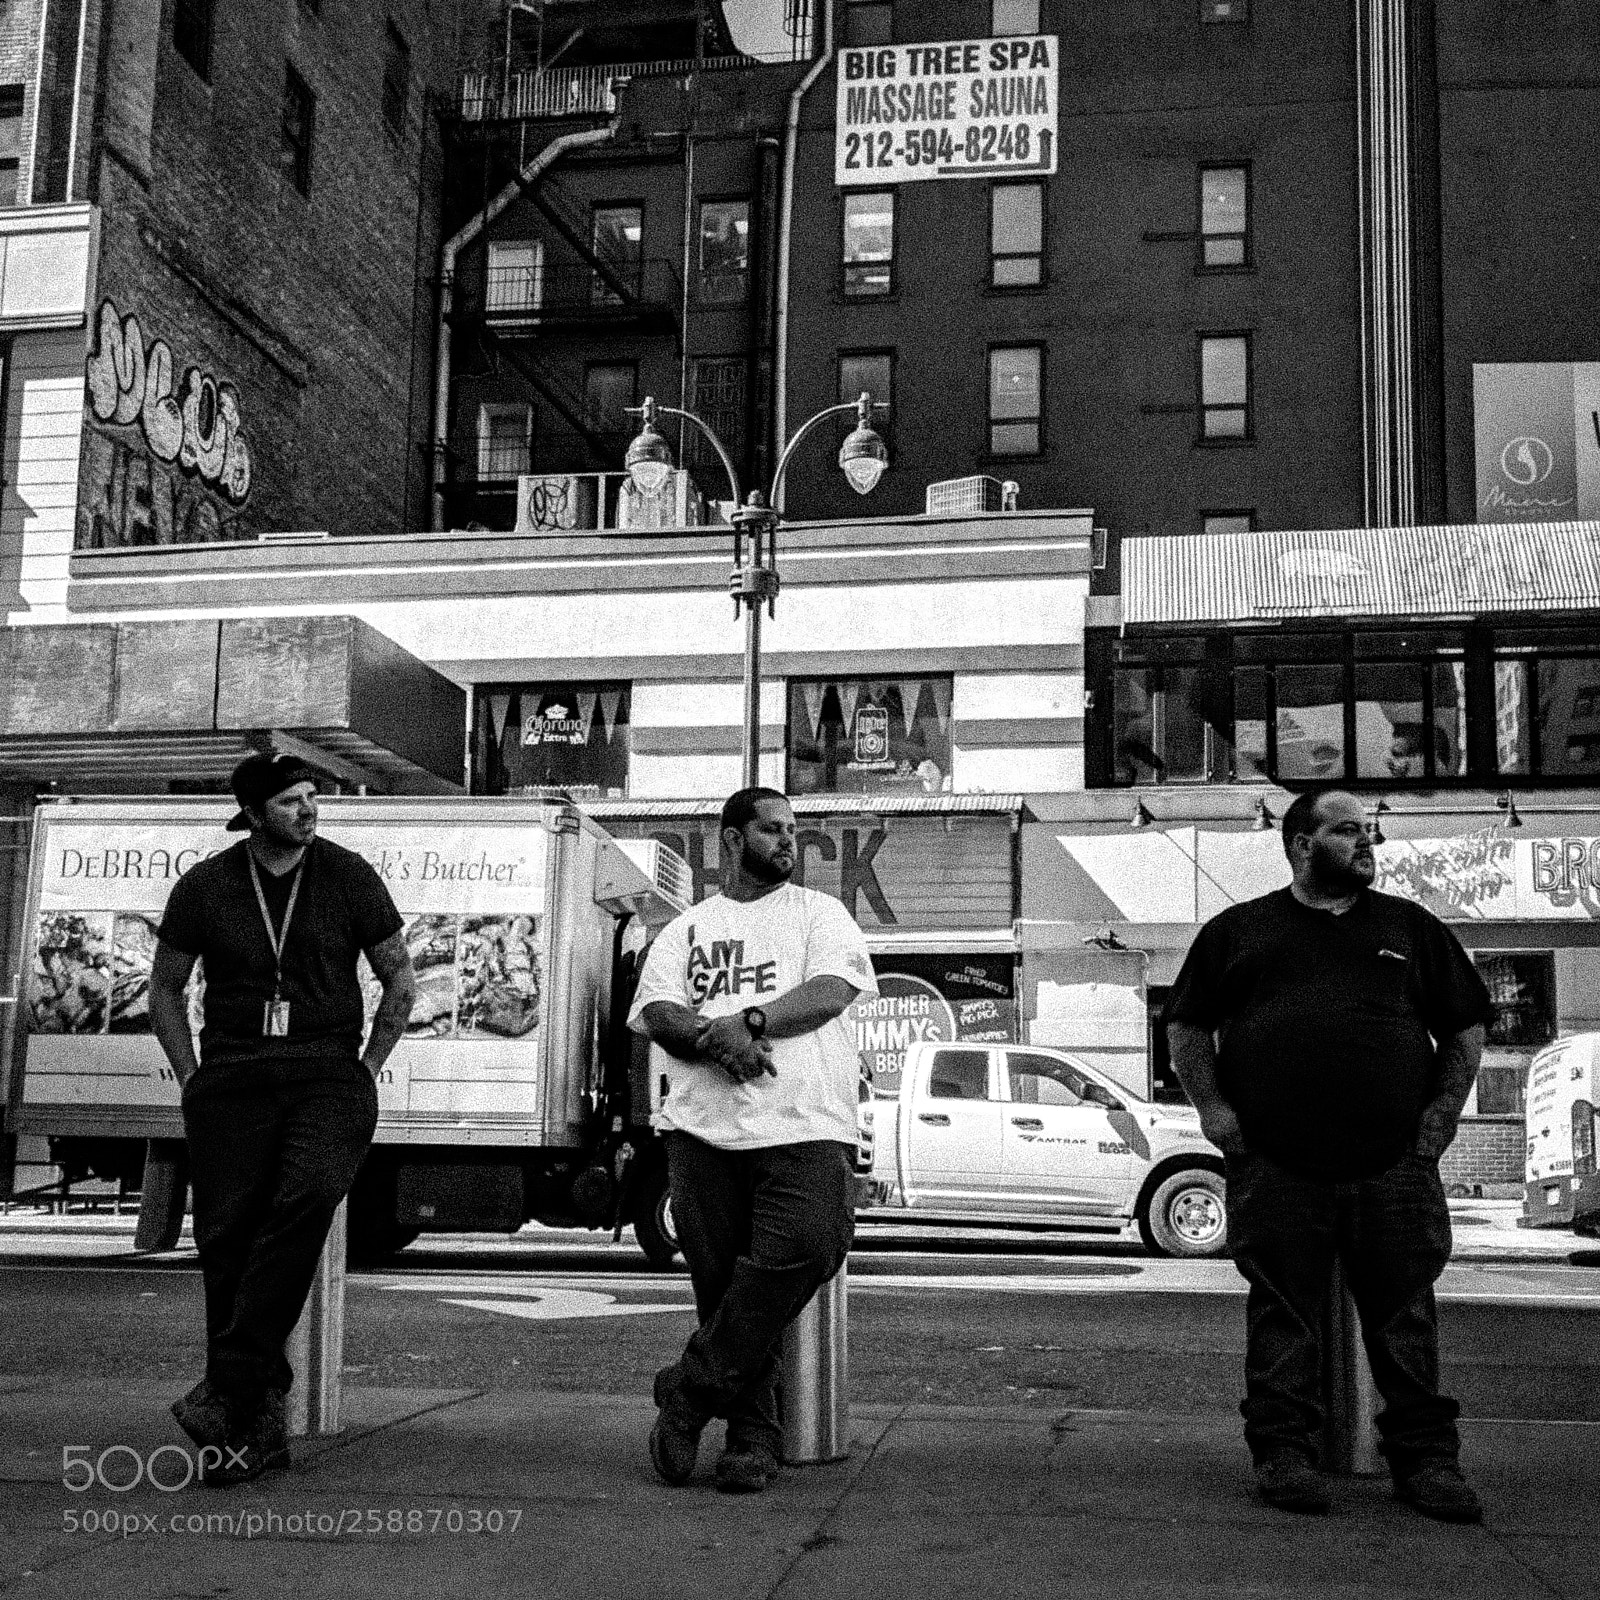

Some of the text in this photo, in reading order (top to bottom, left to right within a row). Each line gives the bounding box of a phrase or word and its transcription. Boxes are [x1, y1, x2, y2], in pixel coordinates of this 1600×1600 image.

[845, 40, 1050, 81] BIG TREE SPA
[846, 75, 1049, 126] MASSAGE SAUNA
[844, 123, 1030, 170] 212-594-8248
[525, 714, 583, 735] Corona
[687, 923, 696, 947] I
[686, 939, 745, 980] AM
[692, 960, 777, 1006] SAFE
[857, 993, 930, 1018] BROTHER
[1036, 1136, 1088, 1145] AMTRAK
